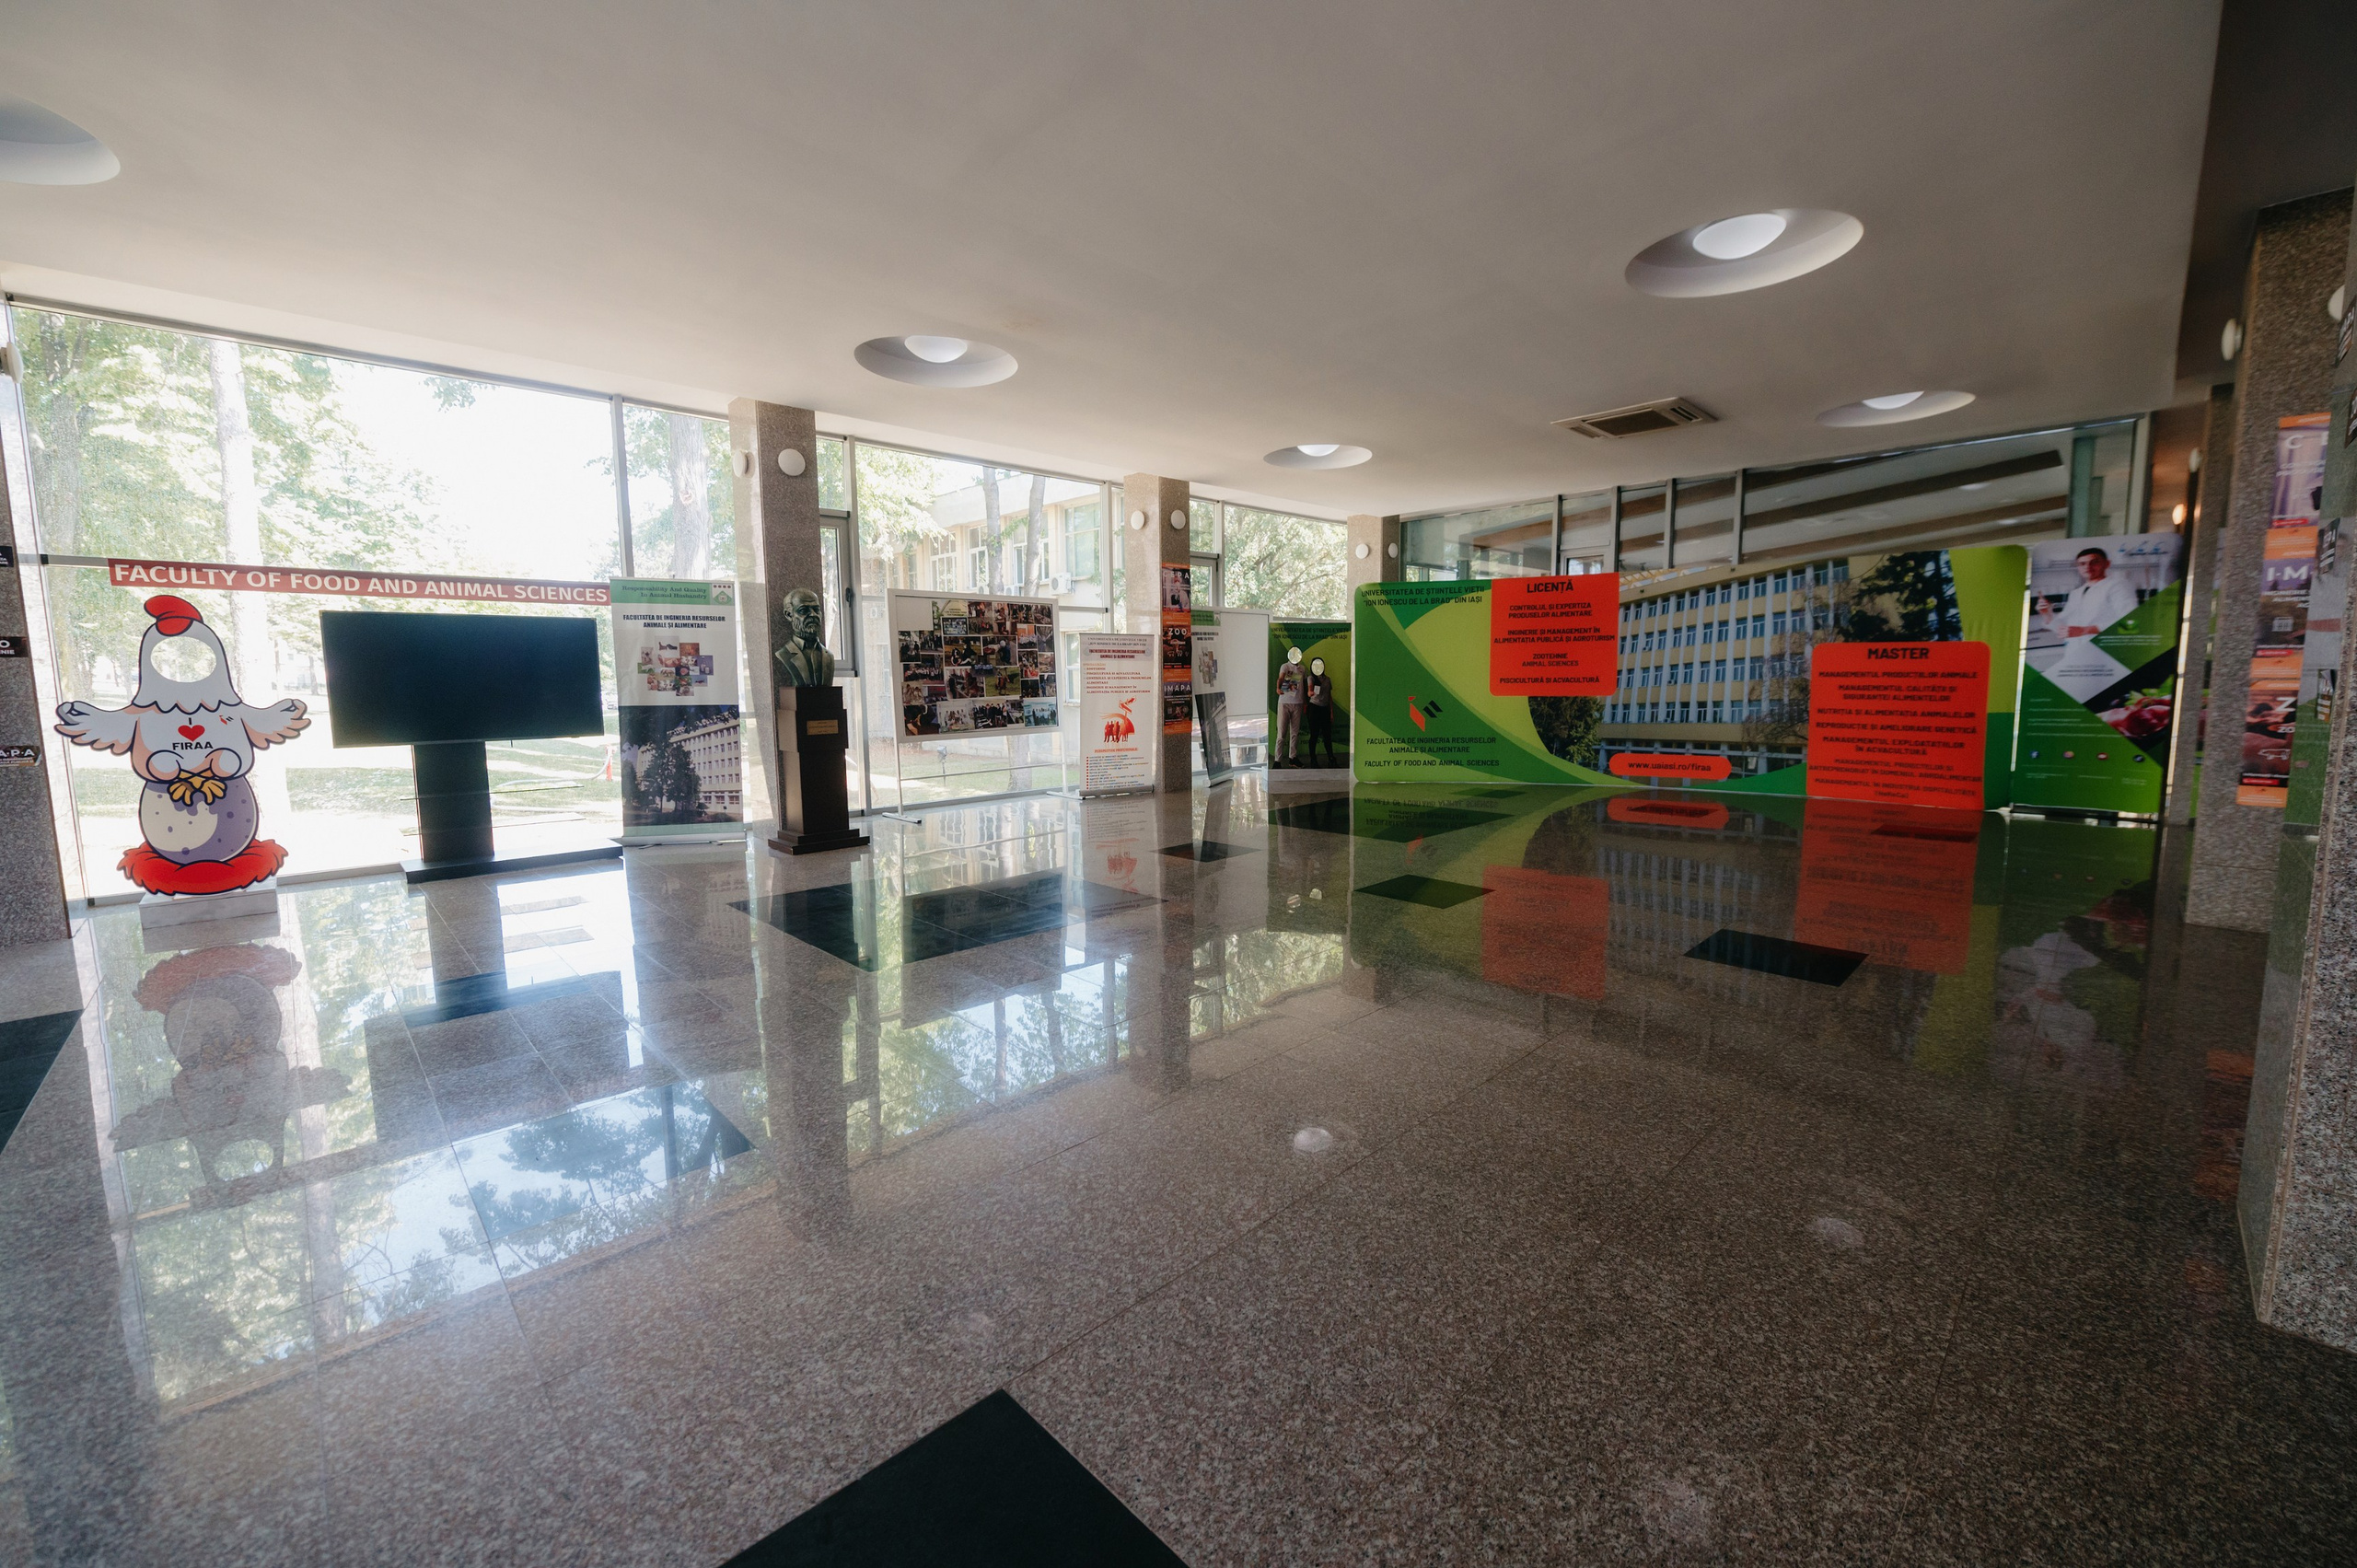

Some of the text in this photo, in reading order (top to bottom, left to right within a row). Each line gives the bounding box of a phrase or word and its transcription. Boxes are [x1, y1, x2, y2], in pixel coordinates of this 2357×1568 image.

[114, 564, 608, 602] FACULTY OF FOOD AND ANIMAL SCIENCES
[1527, 579, 1574, 593] LICENȚĂ
[1362, 588, 1414, 597] UNIVERSITATEA
[1547, 627, 1592, 635] MANAGEMENT
[1867, 647, 1930, 659] MASTER
[172, 741, 214, 750] FIRAA
[1628, 762, 1711, 771] www.uaiasi.ro/firaa
